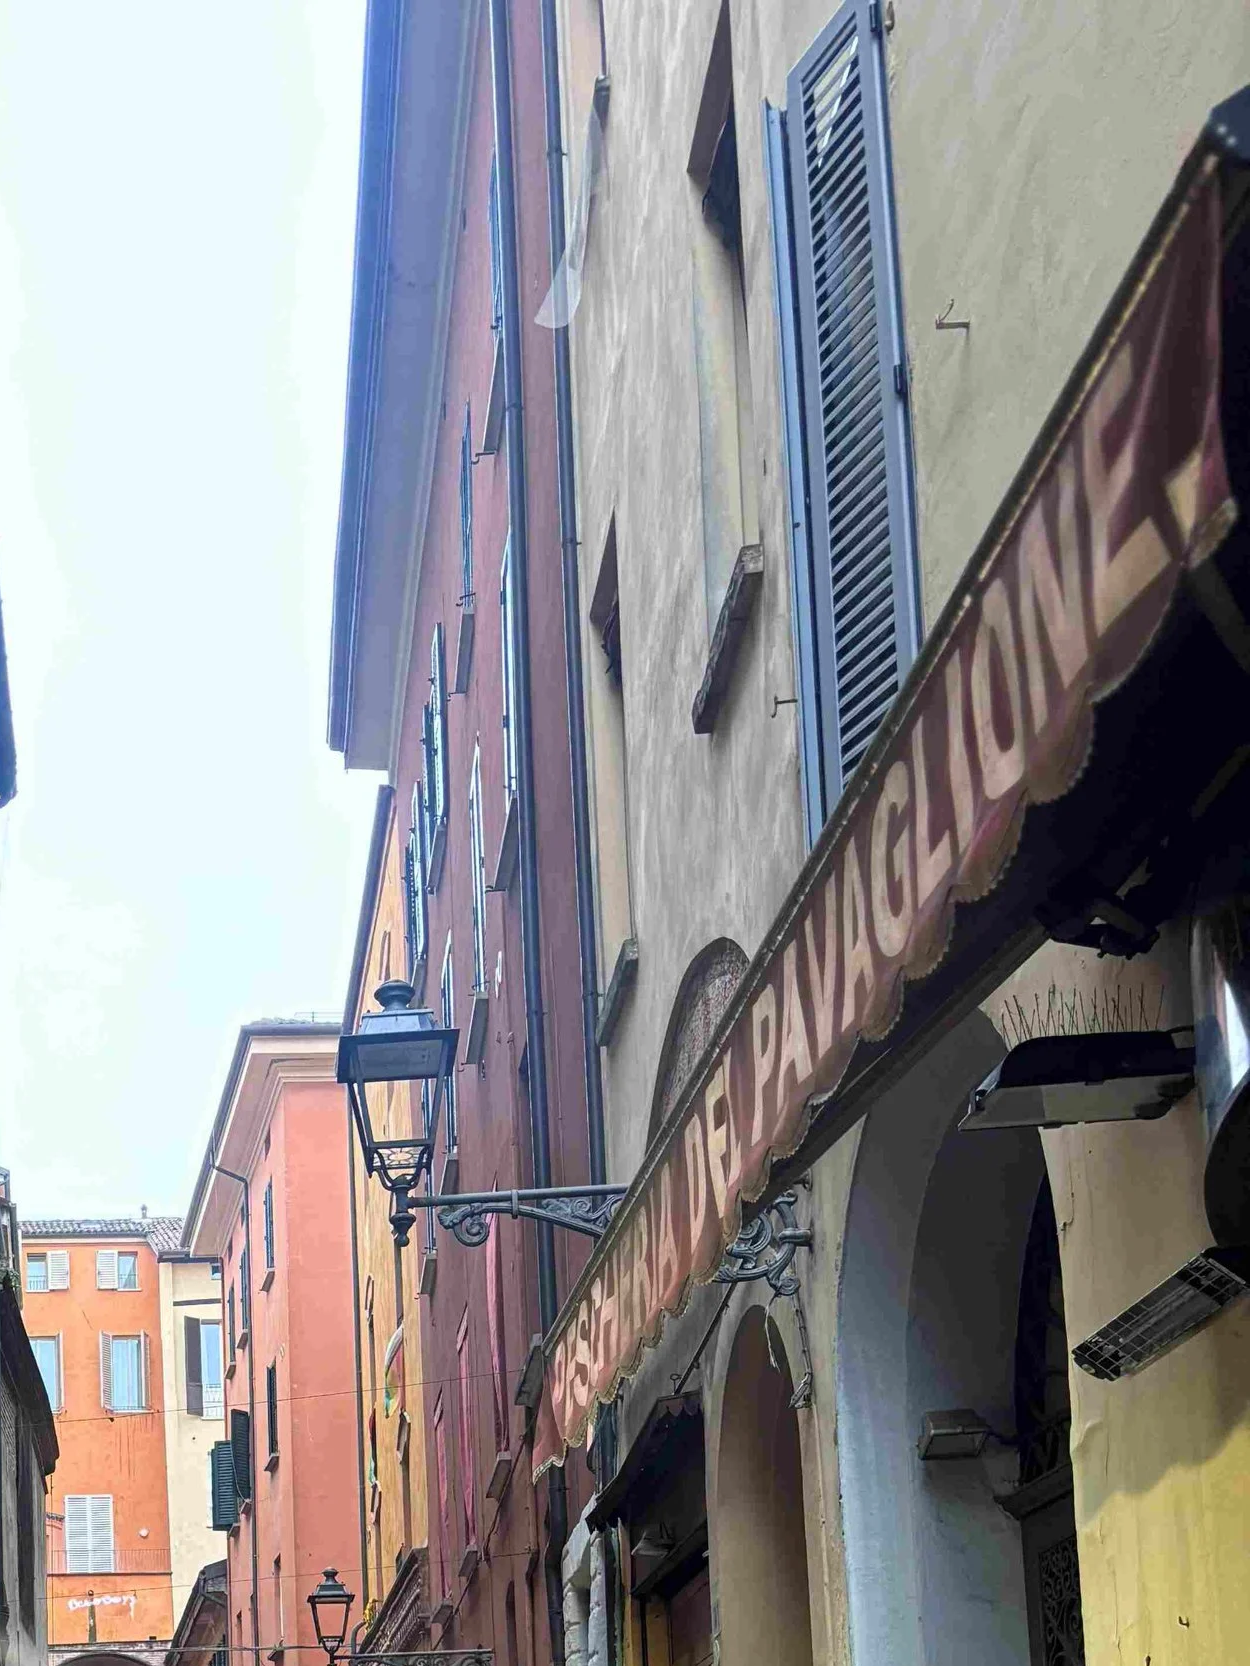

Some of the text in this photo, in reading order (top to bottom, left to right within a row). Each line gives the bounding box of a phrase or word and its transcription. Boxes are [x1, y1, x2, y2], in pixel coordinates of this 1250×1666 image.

[552, 343, 1202, 1420] PESCHERIA DEL PAVAGLIONE
